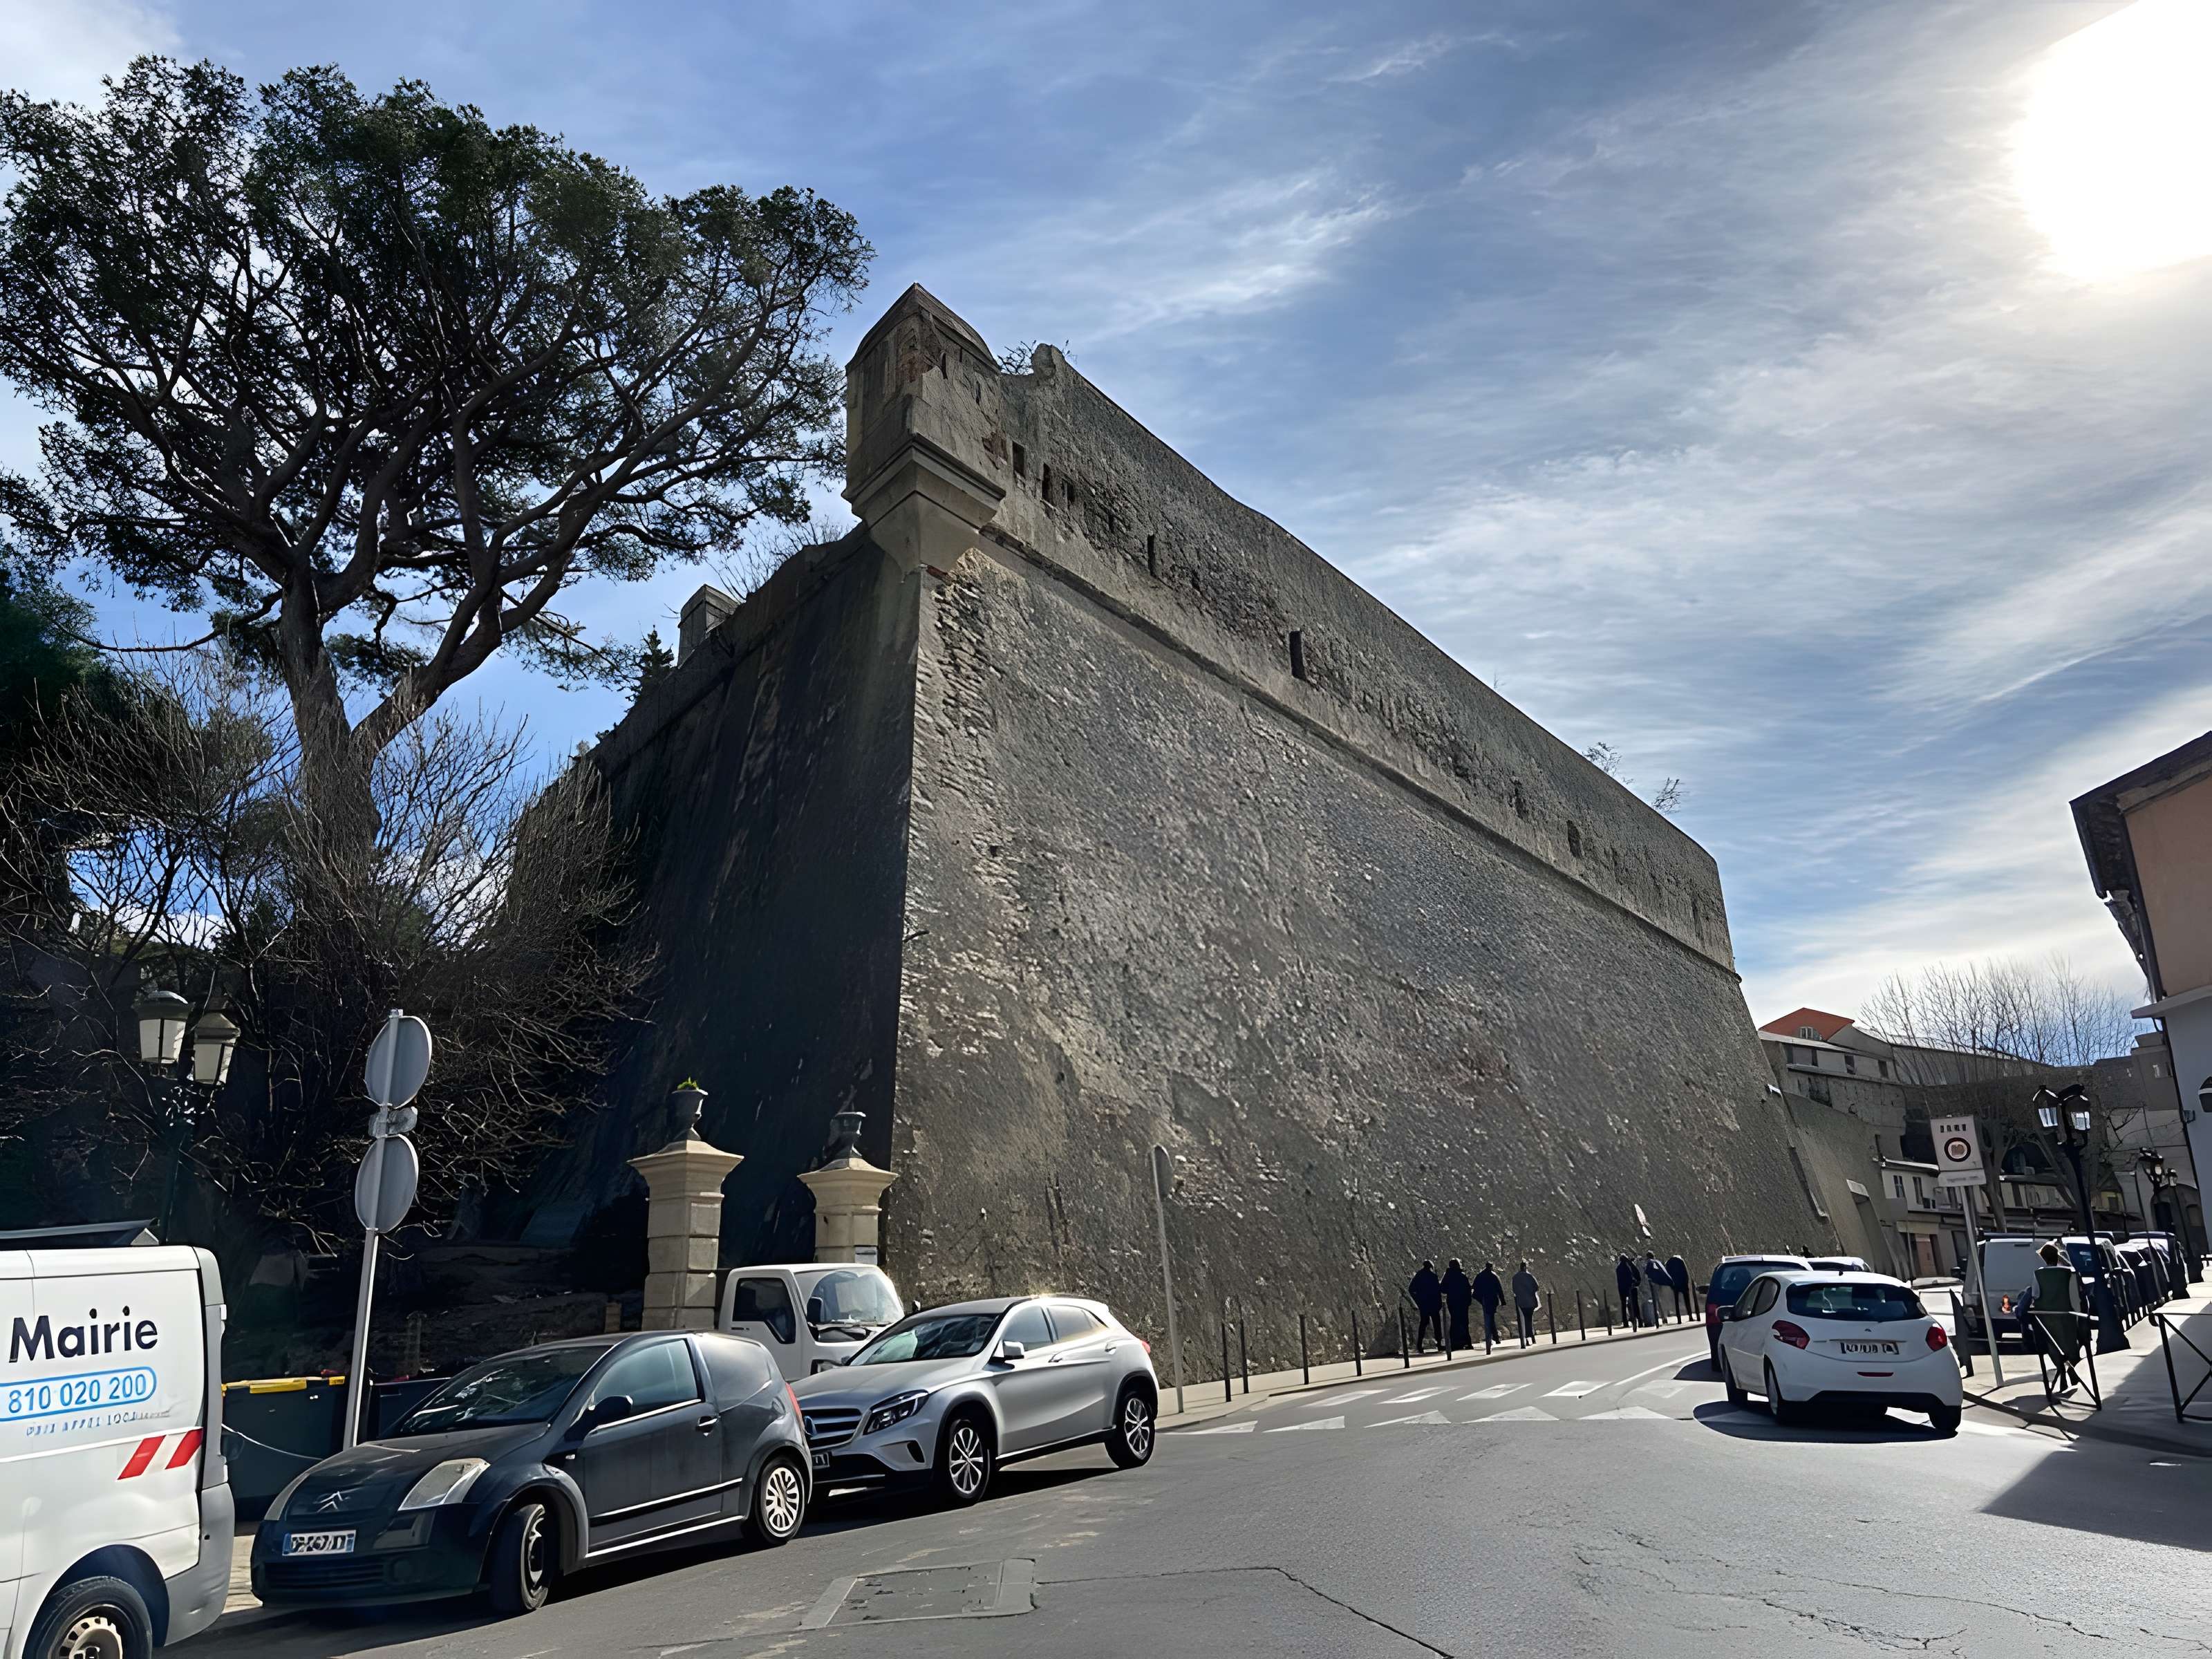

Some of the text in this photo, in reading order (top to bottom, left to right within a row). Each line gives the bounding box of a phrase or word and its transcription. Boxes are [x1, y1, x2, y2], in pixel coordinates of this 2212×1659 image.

[8, 1305, 158, 1362] Mairie
[9, 1374, 147, 1414] 810 020 200
